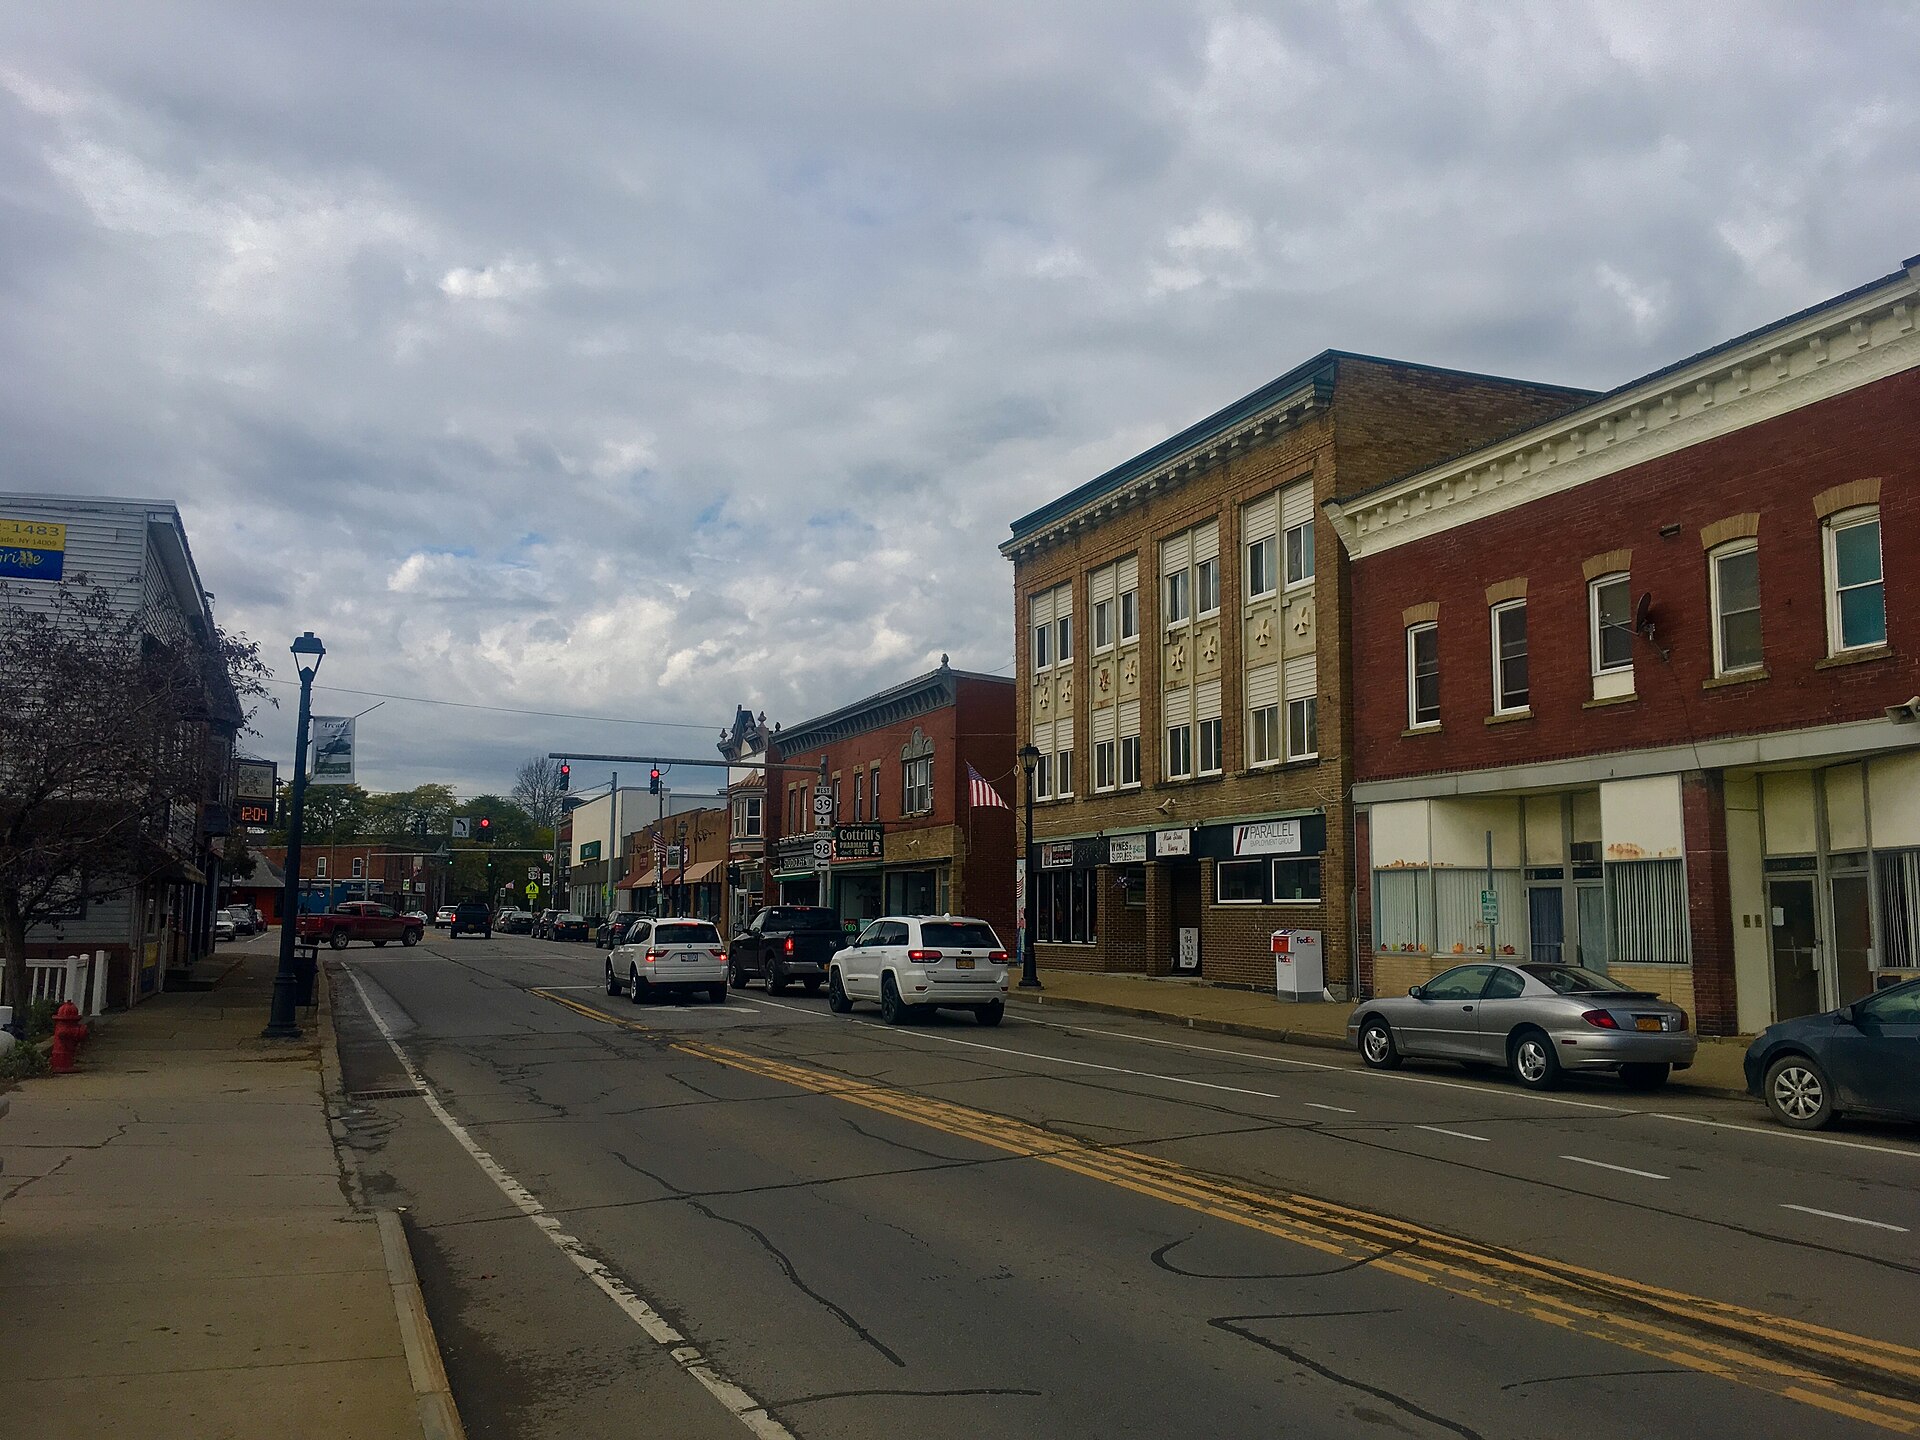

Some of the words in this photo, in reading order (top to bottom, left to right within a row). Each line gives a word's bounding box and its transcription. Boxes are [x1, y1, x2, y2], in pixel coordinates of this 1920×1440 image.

[0, 523, 60, 537] -1483
[32, 538, 57, 547] 14009
[815, 799, 831, 811] 39
[241, 806, 268, 822] 12:04
[814, 831, 832, 839] SOUTH
[839, 829, 881, 841] Cottrill's
[1249, 823, 1295, 840] PARALLEL
[839, 841, 869, 849] PHARMACY
[1249, 838, 1278, 848] EMPLOYMENT
[1277, 837, 1295, 846] GROUP
[815, 843, 831, 855] 98
[853, 848, 870, 856] GIFTS
[1111, 851, 1133, 862] SUPPLIES
[1296, 936, 1315, 944] FedEx
